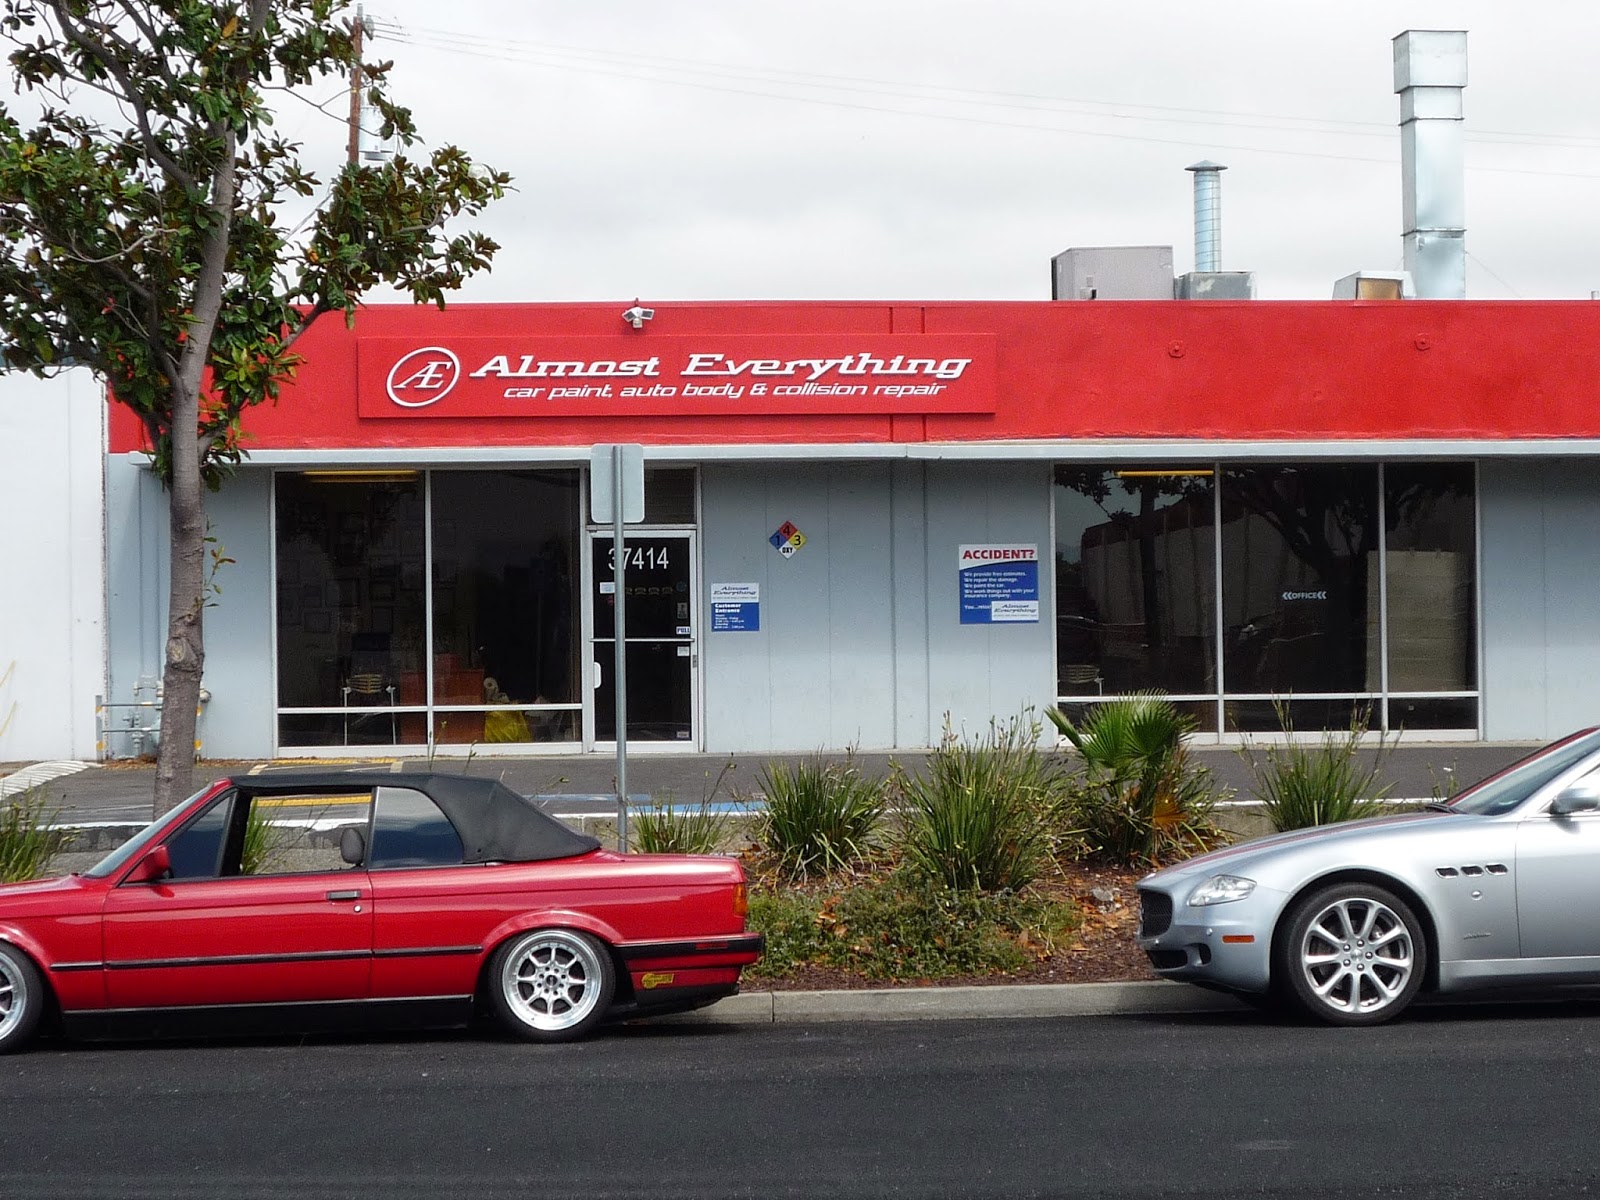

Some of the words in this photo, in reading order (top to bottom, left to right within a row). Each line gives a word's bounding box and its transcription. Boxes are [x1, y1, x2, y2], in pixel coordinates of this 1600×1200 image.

[468, 355, 661, 377] Almost
[680, 352, 972, 380] Everything
[503, 386, 546, 398] car
[547, 384, 613, 400] paint,
[619, 384, 677, 397] auto
[681, 383, 744, 398] body
[750, 383, 768, 395] &
[773, 382, 867, 395] collision
[873, 382, 947, 397] repair
[782, 525, 791, 536] 4
[775, 535, 780, 545] 1
[794, 534, 802, 546] 3
[608, 547, 669, 570] 37414
[962, 549, 1035, 560] ACCIDENT?
